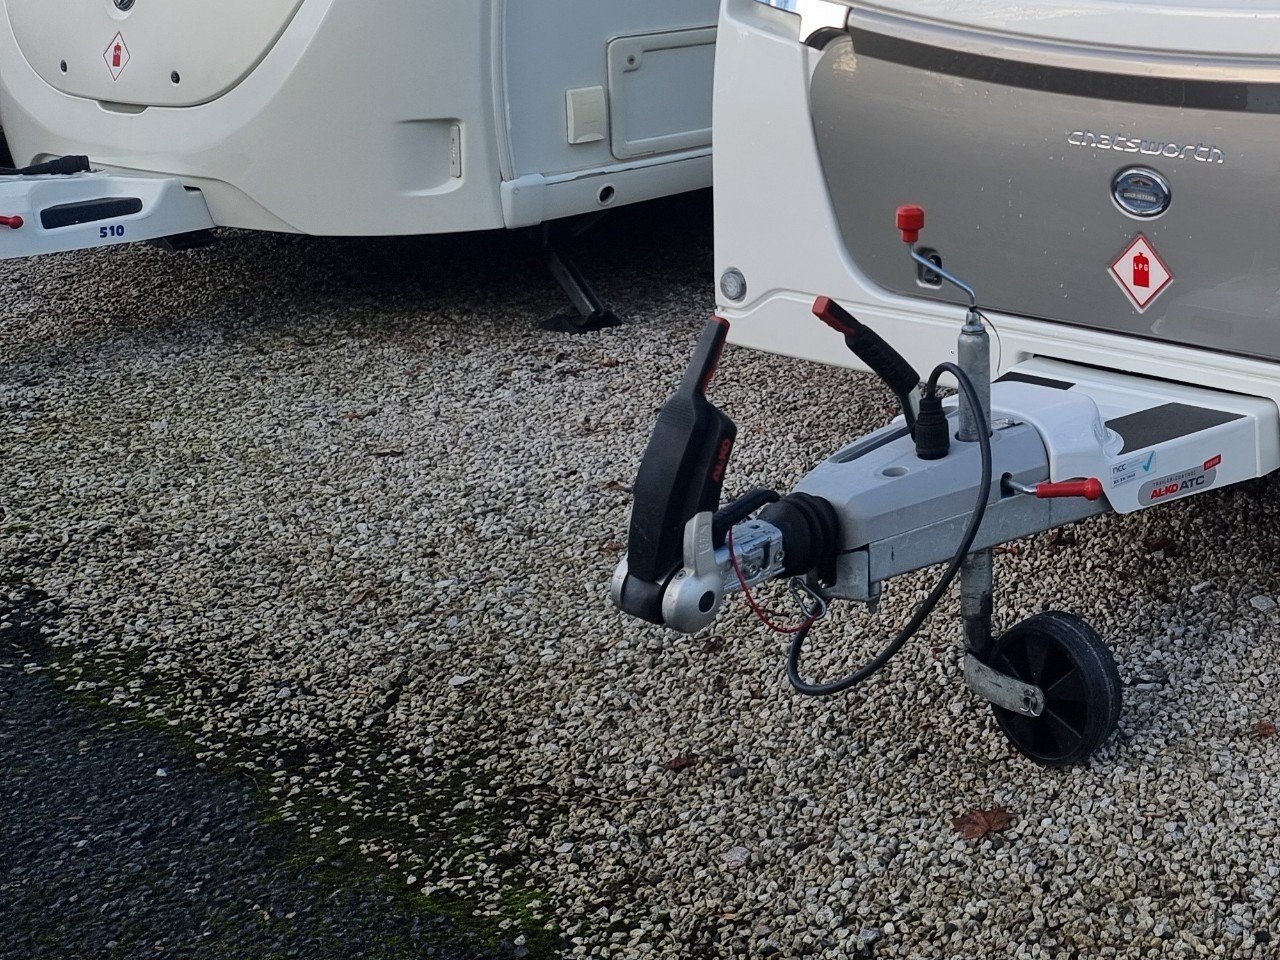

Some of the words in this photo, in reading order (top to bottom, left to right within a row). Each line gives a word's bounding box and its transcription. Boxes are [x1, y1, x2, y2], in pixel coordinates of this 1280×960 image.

[1066, 129, 1226, 164] chatsworth
[99, 225, 125, 238] 510
[1135, 262, 1149, 271] LPG
[1179, 475, 1205, 491] ATC
